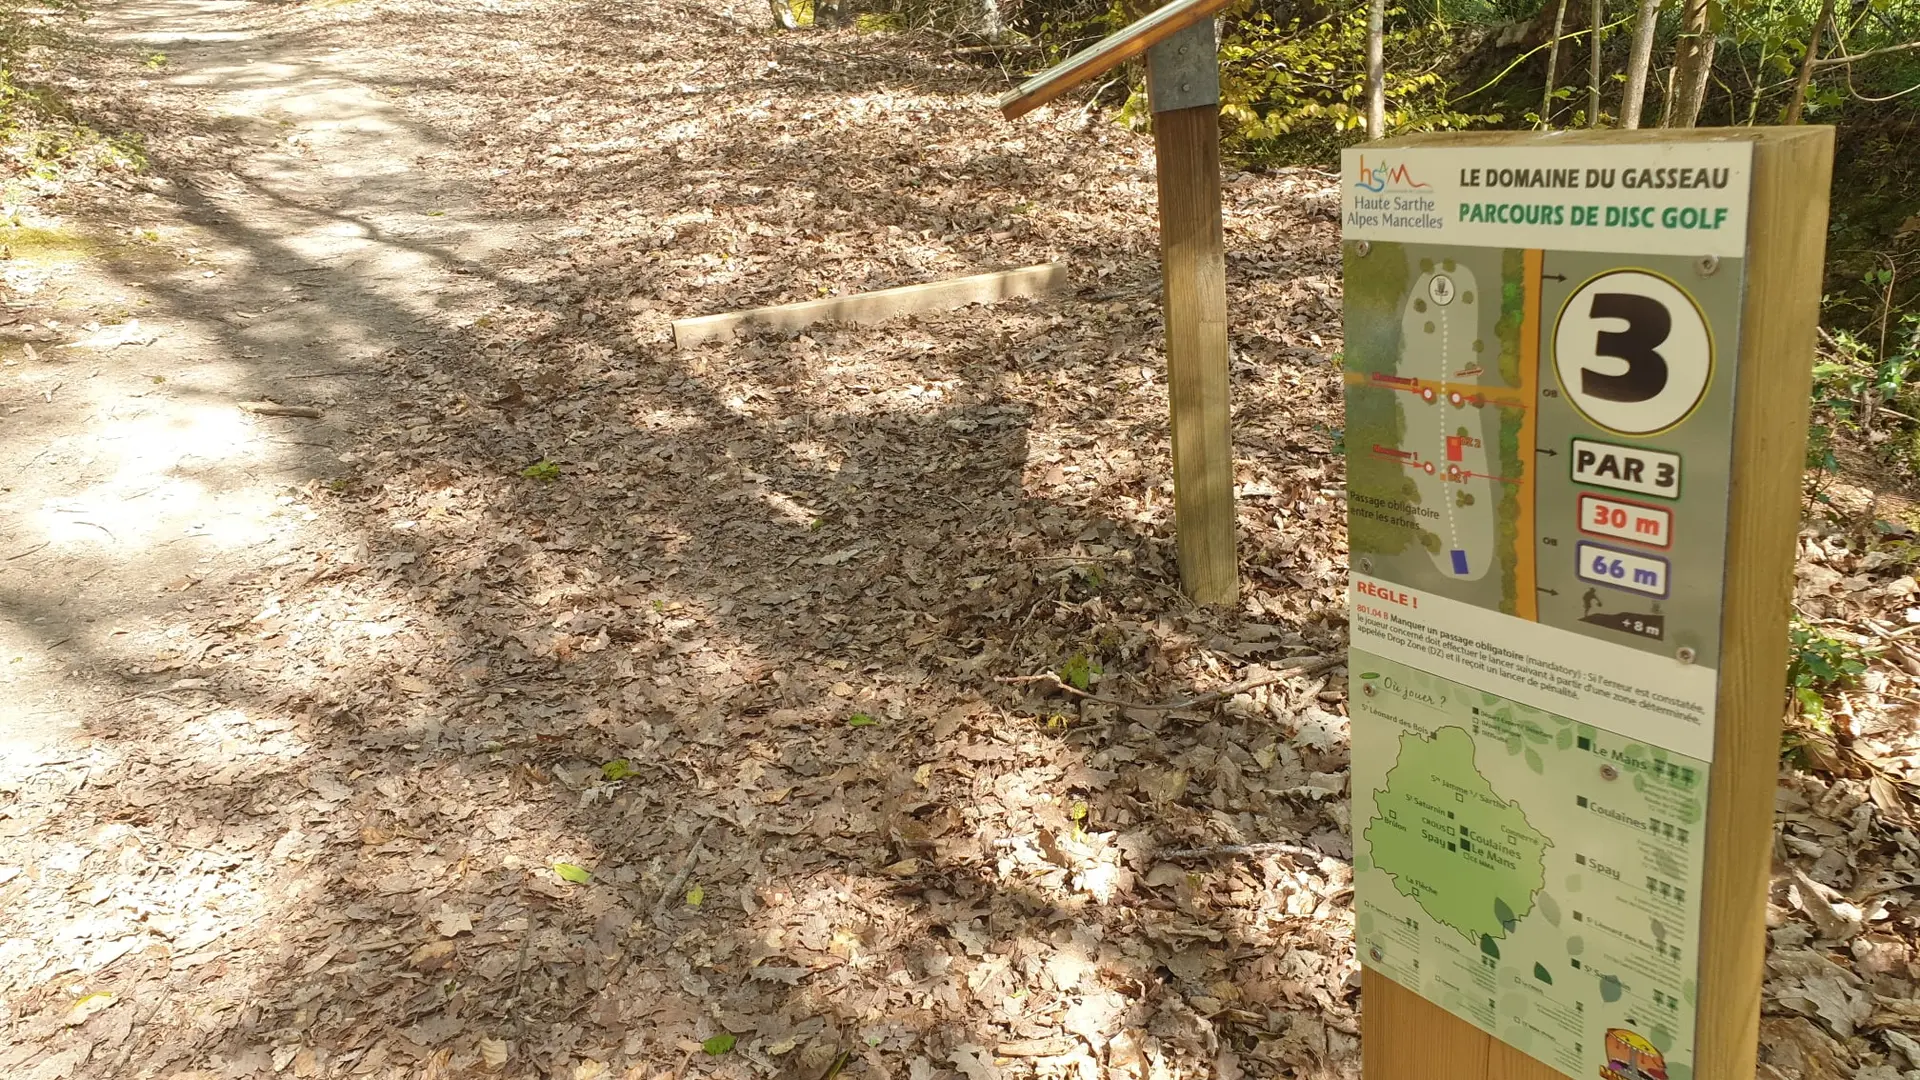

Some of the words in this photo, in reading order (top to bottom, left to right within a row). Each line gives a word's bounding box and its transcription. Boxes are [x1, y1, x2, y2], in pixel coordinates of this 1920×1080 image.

[1460, 168, 1480, 187] LE
[1485, 168, 1580, 189] DOMAINE
[1585, 168, 1616, 189] DU
[1621, 167, 1730, 189] GASSEAU
[1354, 196, 1390, 211] Haute
[1393, 196, 1436, 212] Sarthe
[1459, 203, 1564, 226] PARCOURS
[1570, 206, 1600, 227] DE
[1604, 206, 1656, 228] DISC
[1661, 207, 1729, 230] GOLF
[1347, 211, 1379, 229] Alpes
[1381, 213, 1444, 230] Mancelles
[1580, 293, 1672, 403] 3
[1576, 450, 1645, 484] PAR
[1655, 462, 1675, 488] 3
[1350, 490, 1386, 508] Passage
[1387, 499, 1440, 519] obligatoire
[1350, 506, 1374, 519] entre
[1376, 511, 1389, 523] les
[1391, 516, 1421, 530] arbres
[1593, 505, 1628, 529] 30
[1635, 516, 1660, 537] m
[1592, 556, 1625, 579] 66
[1633, 567, 1658, 587] m
[1356, 580, 1409, 607] RÈGLE
[1412, 597, 1418, 609] !
[1621, 618, 1632, 628] +
[1633, 620, 1644, 632] 8
[1645, 625, 1660, 636] m
[1357, 604, 1382, 618] 801.04
[1383, 611, 1389, 620] B
[1390, 614, 1426, 631] Manquer
[1427, 626, 1438, 636] un
[1440, 630, 1474, 647] passage
[1475, 641, 1524, 661] obligatoire
[1526, 654, 1582, 680] (mandatory)
[1587, 672, 1597, 683] Si
[1635, 688, 1650, 698] est
[1357, 625, 1386, 640] appelée
[1387, 632, 1406, 647] Drop
[1407, 639, 1427, 653] Zone
[1427, 646, 1445, 659] (DZ)
[1445, 652, 1454, 662] et
[1455, 653, 1460, 664] il
[1461, 658, 1485, 671] reçoit
[1486, 665, 1498, 675] un
[1499, 667, 1526, 683] lancer
[1526, 677, 1539, 688] de
[1357, 613, 1364, 623] le
[1365, 617, 1389, 630] joueur
[1389, 626, 1424, 642] concerné
[1425, 634, 1441, 647] doit
[1442, 641, 1479, 658] effectuer
[1479, 650, 1487, 661] le
[1488, 653, 1514, 669] lancer
[1515, 664, 1548, 680] suivant
[1549, 672, 1555, 682] à
[1556, 676, 1582, 690] partir
[1583, 683, 1611, 698] d'une
[1613, 692, 1637, 706] zone
[1384, 676, 1401, 693] Où
[1401, 687, 1435, 705] jouer
[1440, 695, 1447, 708] ?
[1398, 718, 1412, 729] des
[1412, 723, 1429, 735] Bois
[1592, 743, 1608, 757] Le
[1611, 750, 1648, 770] Mans
[1414, 797, 1446, 816] Saturnin
[1589, 801, 1648, 830] Coulaines
[1421, 829, 1446, 849] Spay
[1469, 830, 1522, 860] Coulaines
[1472, 843, 1485, 857] Le
[1486, 850, 1517, 870] Mans
[1588, 858, 1621, 881] Spay
